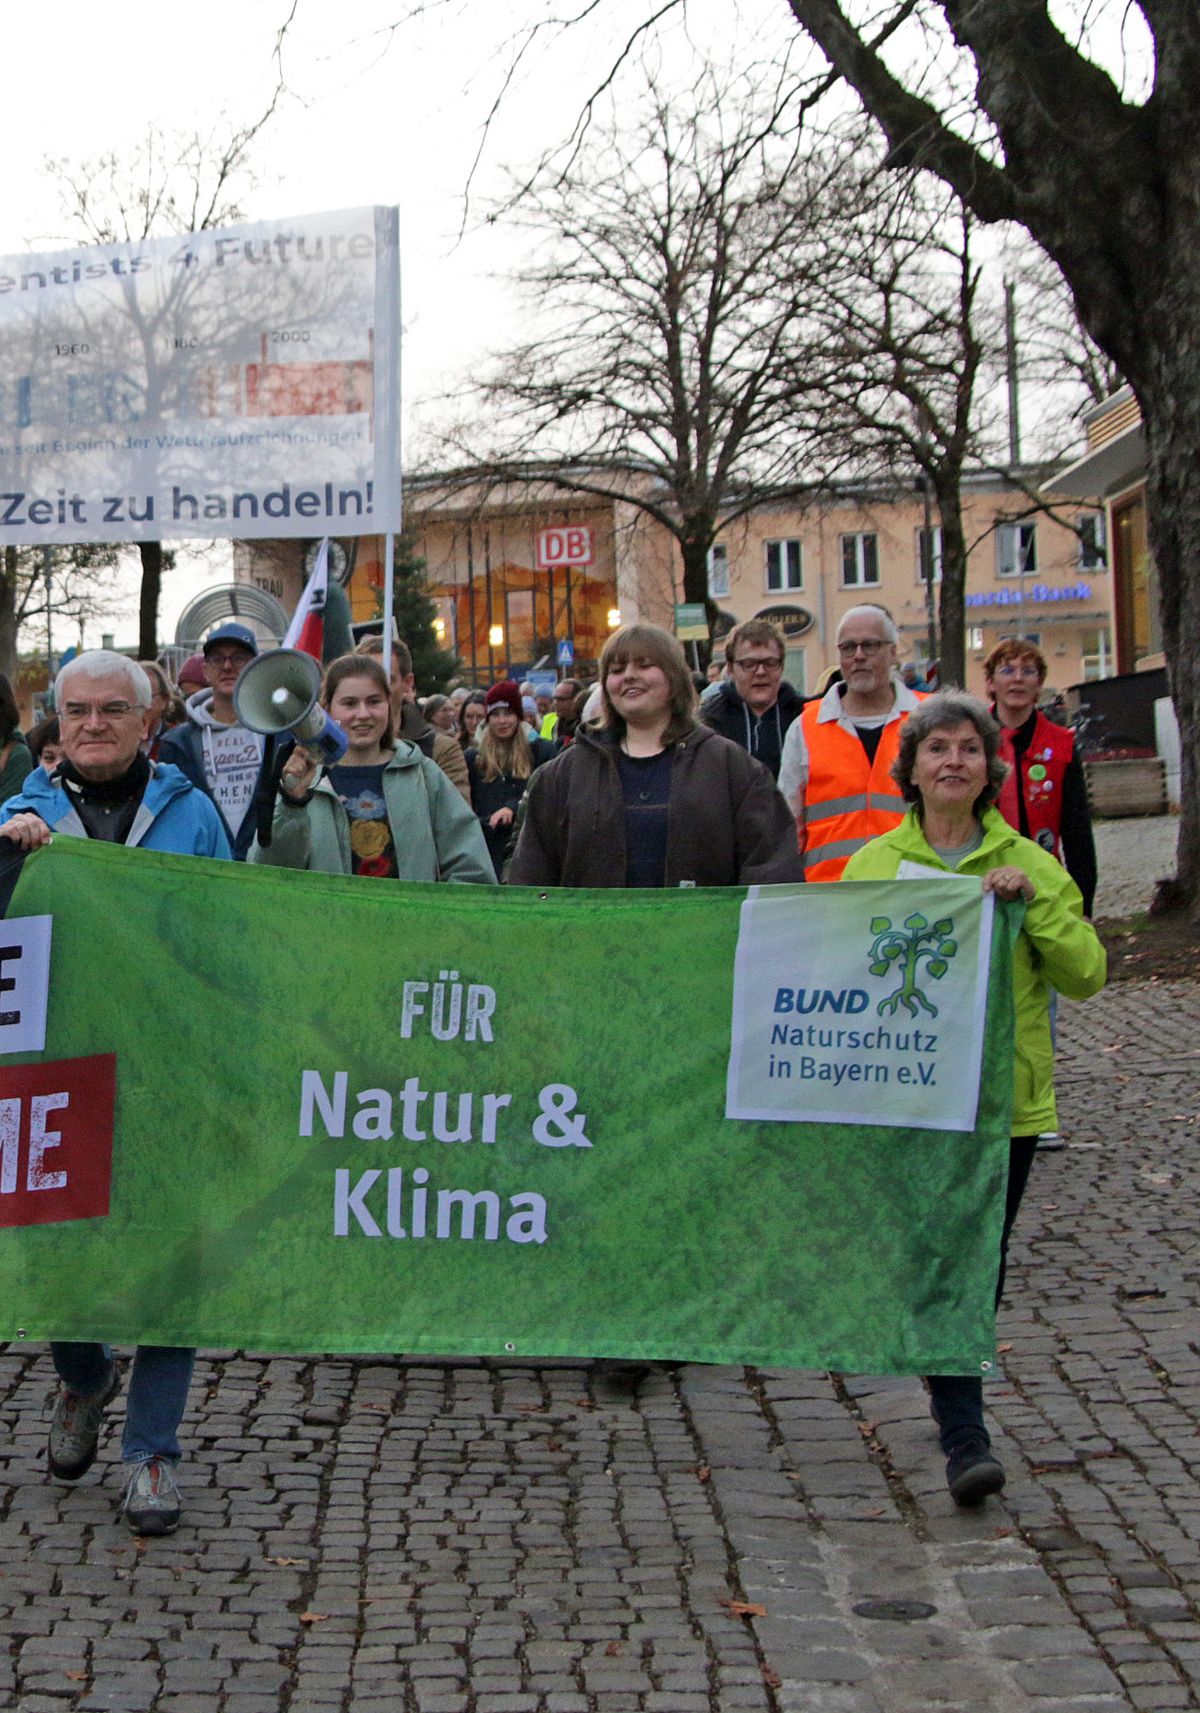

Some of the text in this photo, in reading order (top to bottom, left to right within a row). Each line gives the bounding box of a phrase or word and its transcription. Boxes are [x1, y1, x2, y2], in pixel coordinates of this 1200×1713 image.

[214, 232, 376, 267] Future
[56, 343, 90, 356] 1960
[271, 330, 311, 343] 2000
[102, 495, 155, 523] zu
[172, 480, 374, 520] handeln!
[545, 529, 586, 560] DB
[399, 969, 497, 1043] FÜR
[773, 987, 870, 1015] BUND
[770, 1023, 938, 1053] Naturschutz
[768, 1053, 937, 1087] in Bayern e.V.
[299, 1069, 594, 1149] Natur &
[333, 1166, 549, 1245] Klima
